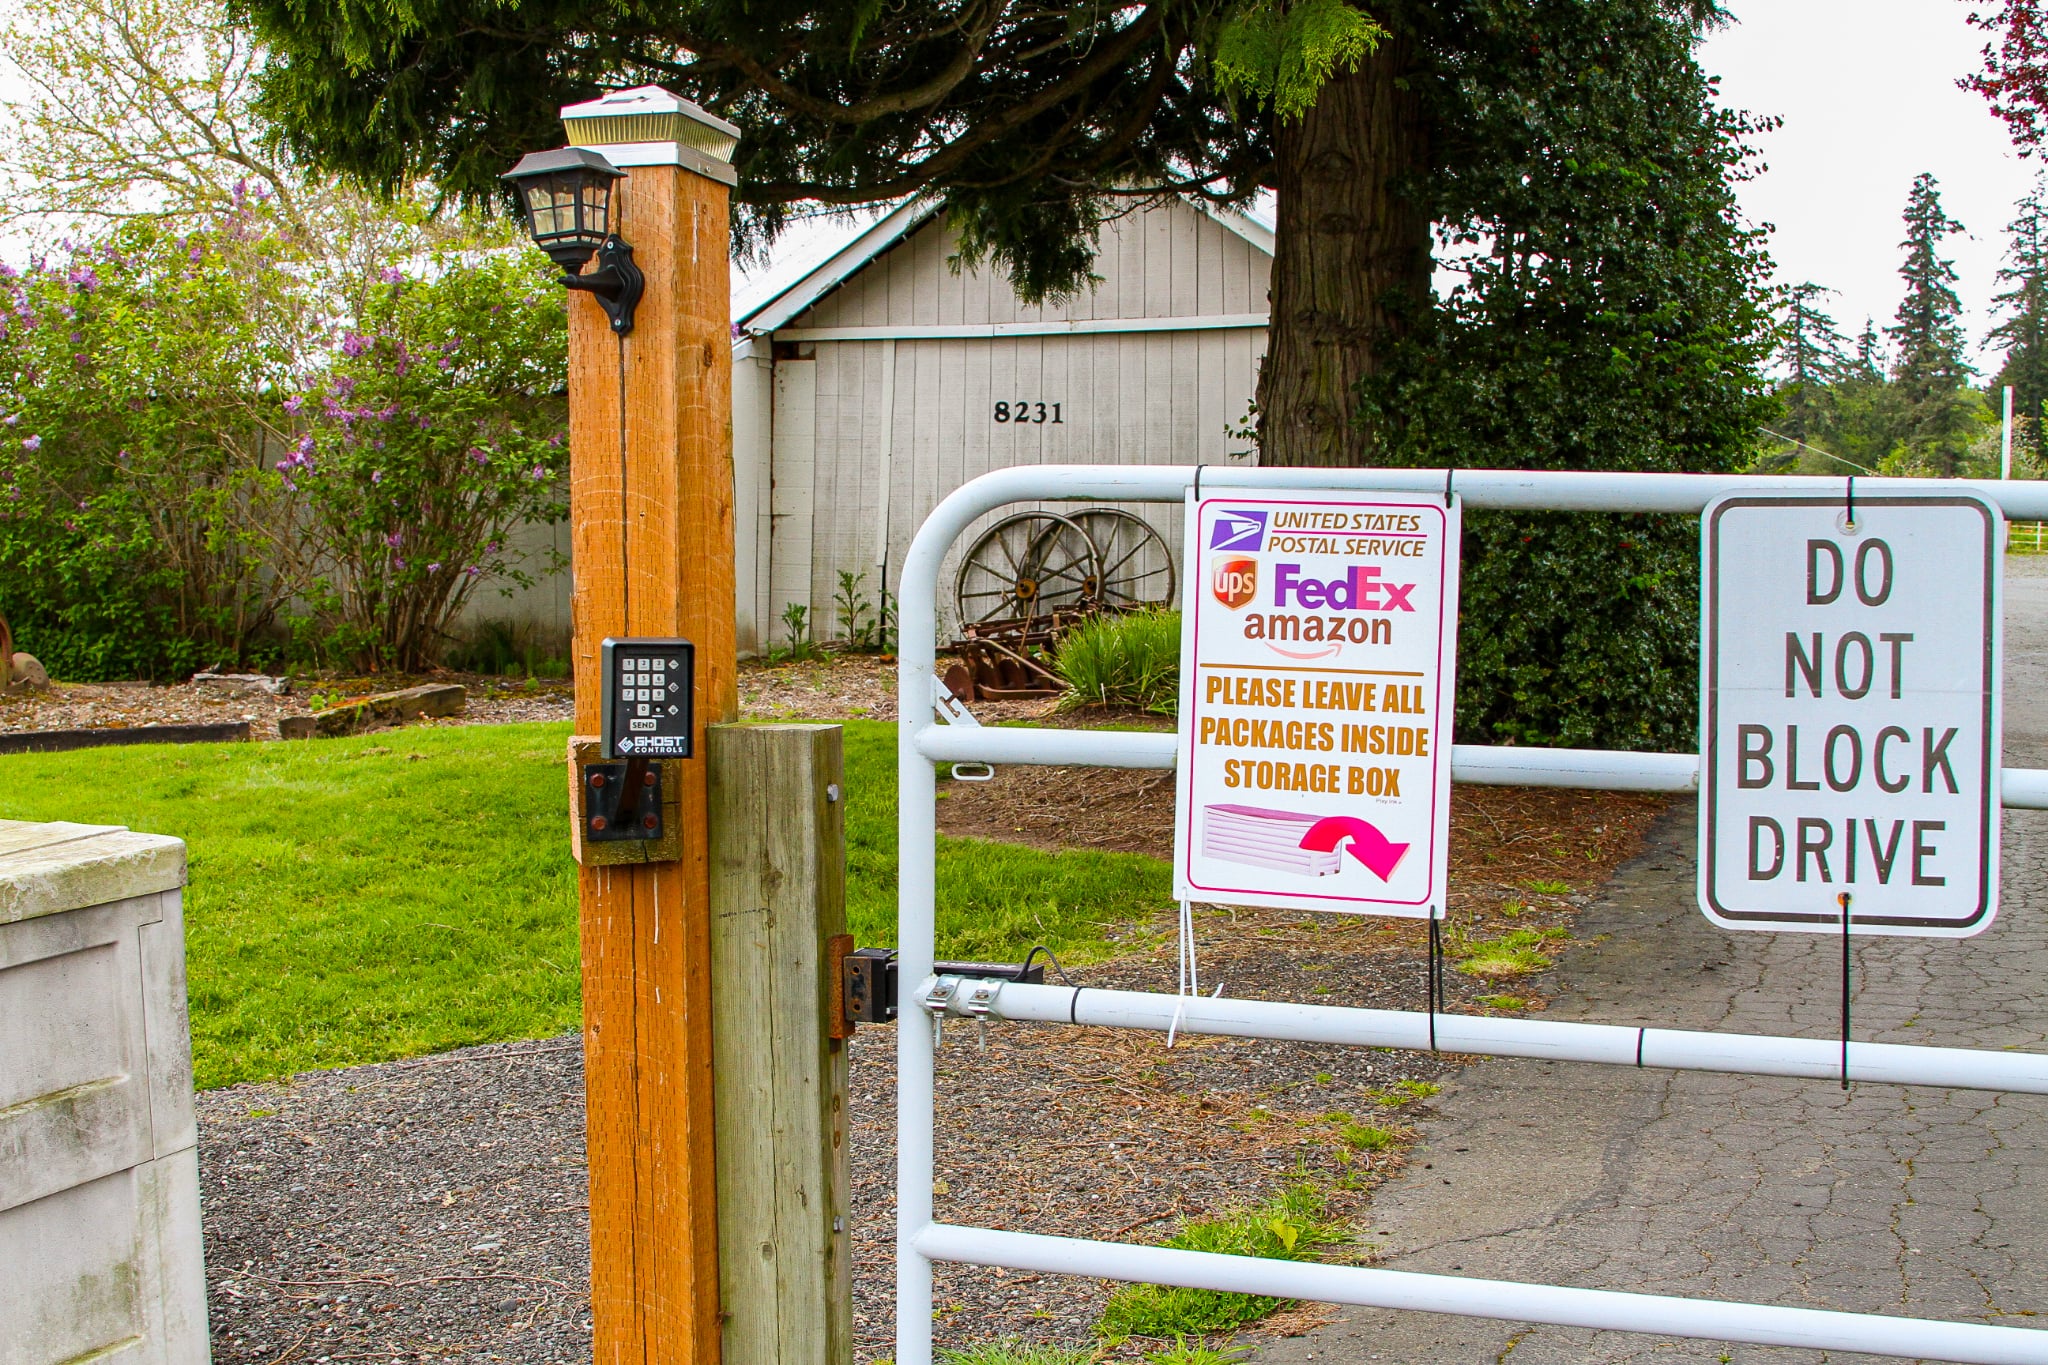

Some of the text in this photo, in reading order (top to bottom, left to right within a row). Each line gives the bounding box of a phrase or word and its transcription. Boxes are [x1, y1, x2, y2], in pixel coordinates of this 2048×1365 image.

[994, 401, 1063, 424] 8231
[1274, 512, 1421, 532] UNITED STATES
[1267, 536, 1426, 557] POSTAL SERVICE
[1215, 572, 1254, 602] ups
[1274, 563, 1416, 612] FedEx
[1806, 537, 1894, 607] DO
[1244, 613, 1392, 645] amazon
[1785, 630, 1915, 700] NOT
[1206, 676, 1425, 714] PLEASE LEAVE ALL
[634, 736, 685, 746] GHOST
[1200, 716, 1429, 757] PACKAGES INSIDE
[1224, 758, 1400, 797] STORAGE BOX
[1737, 723, 1960, 795] BLOCK
[1748, 815, 1946, 887] DRIVE
